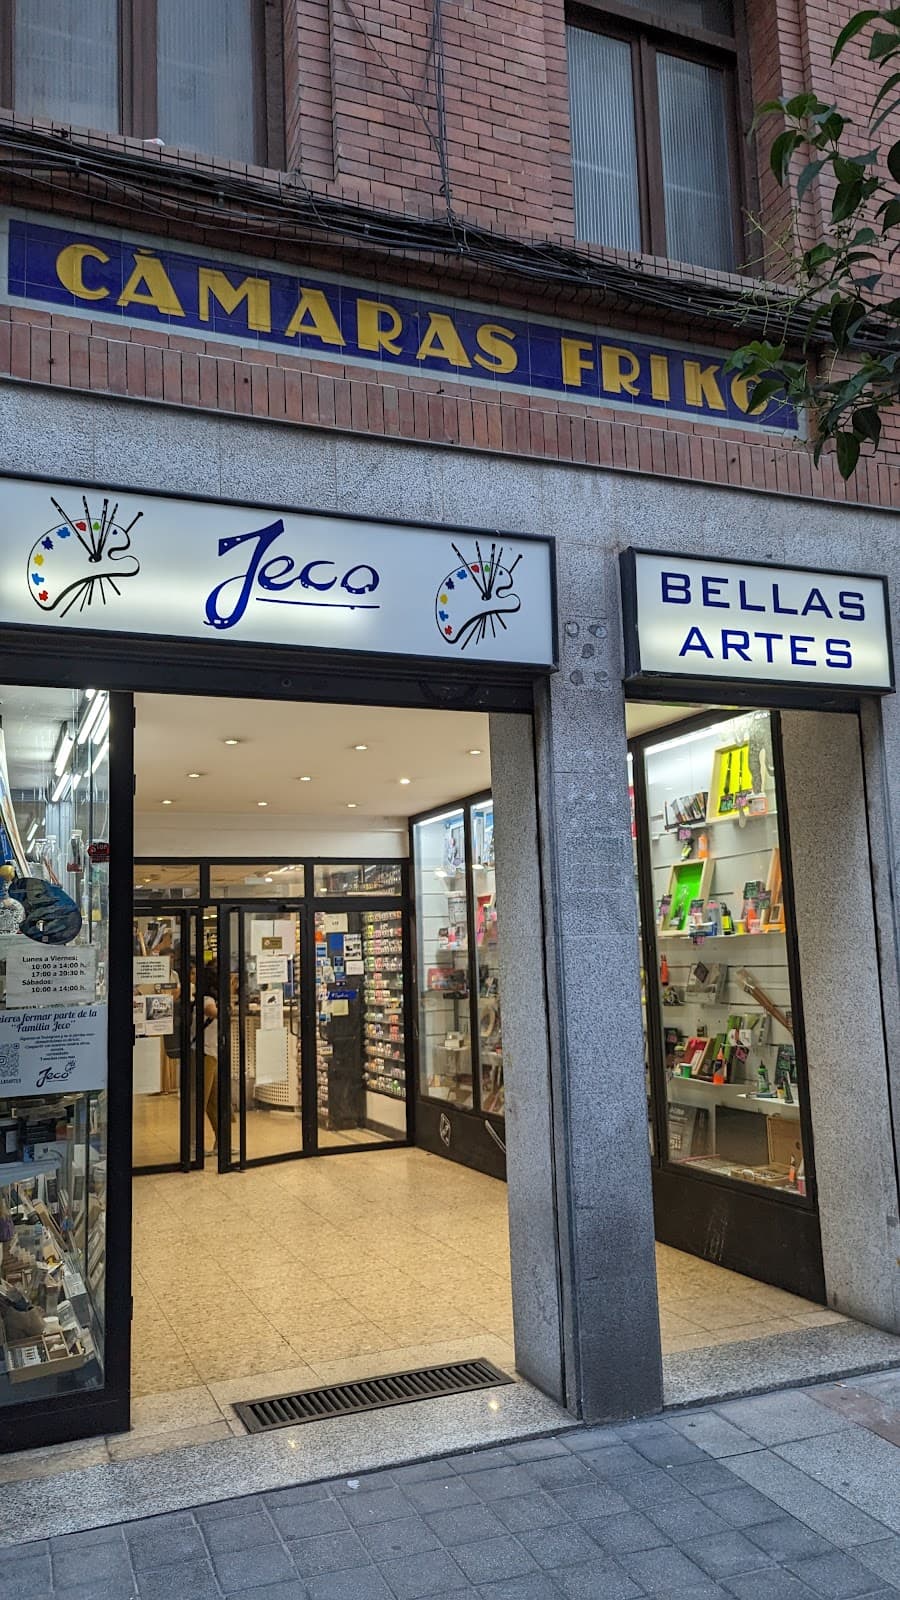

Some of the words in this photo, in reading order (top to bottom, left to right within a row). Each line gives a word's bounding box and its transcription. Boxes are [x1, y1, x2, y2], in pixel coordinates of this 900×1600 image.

[203, 518, 380, 629] Jeco
[661, 571, 866, 621] BELLAS
[679, 626, 853, 669] ARTES
[21, 1013, 52, 1025] formar
[53, 1011, 76, 1022] parte
[77, 1009, 87, 1018] de
[88, 1009, 97, 1017] la
[36, 1066, 70, 1088] Jeco
